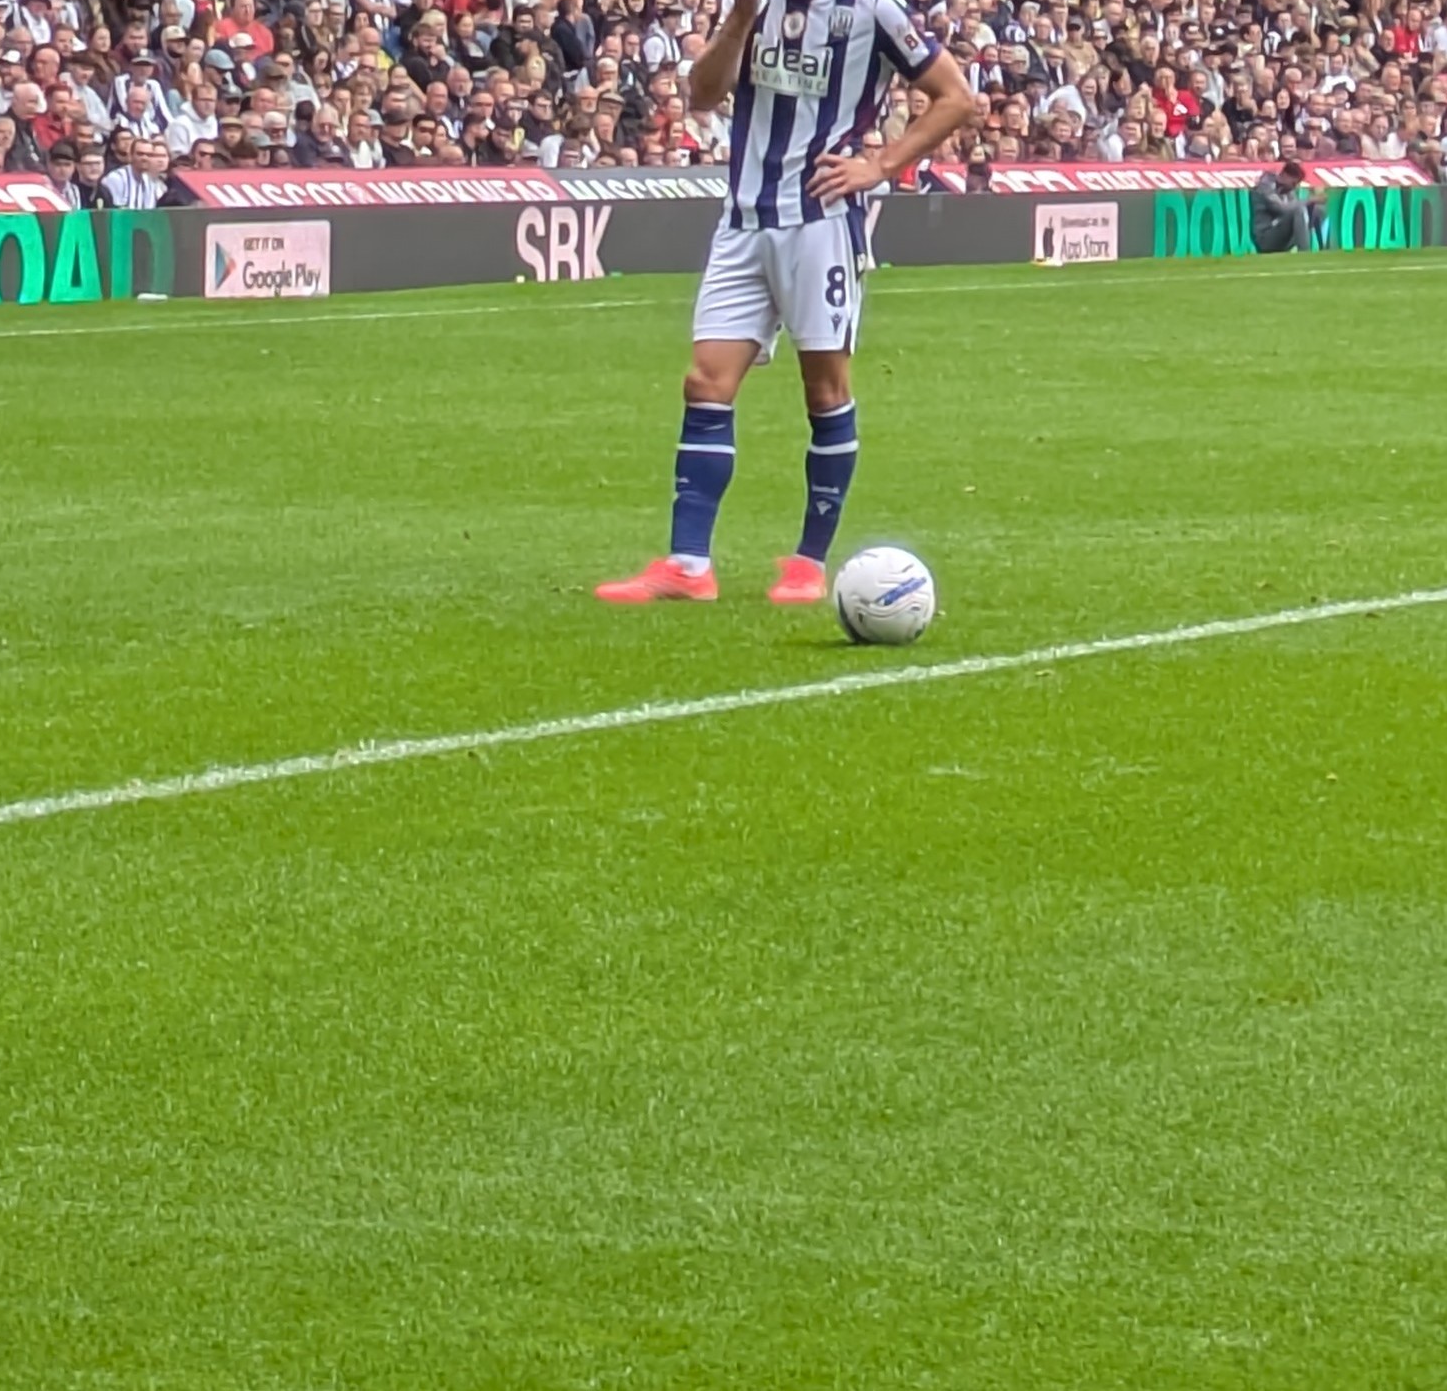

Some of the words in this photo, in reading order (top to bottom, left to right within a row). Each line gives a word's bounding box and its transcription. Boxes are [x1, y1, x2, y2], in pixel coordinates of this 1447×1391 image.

[752, 38, 830, 77] ideal
[243, 237, 260, 251] GET
[261, 237, 270, 251] IT
[1060, 233, 1082, 260] App
[1083, 233, 1110, 259] Store
[243, 259, 293, 296] Google
[295, 262, 321, 291] Play
[825, 265, 846, 308] 8
